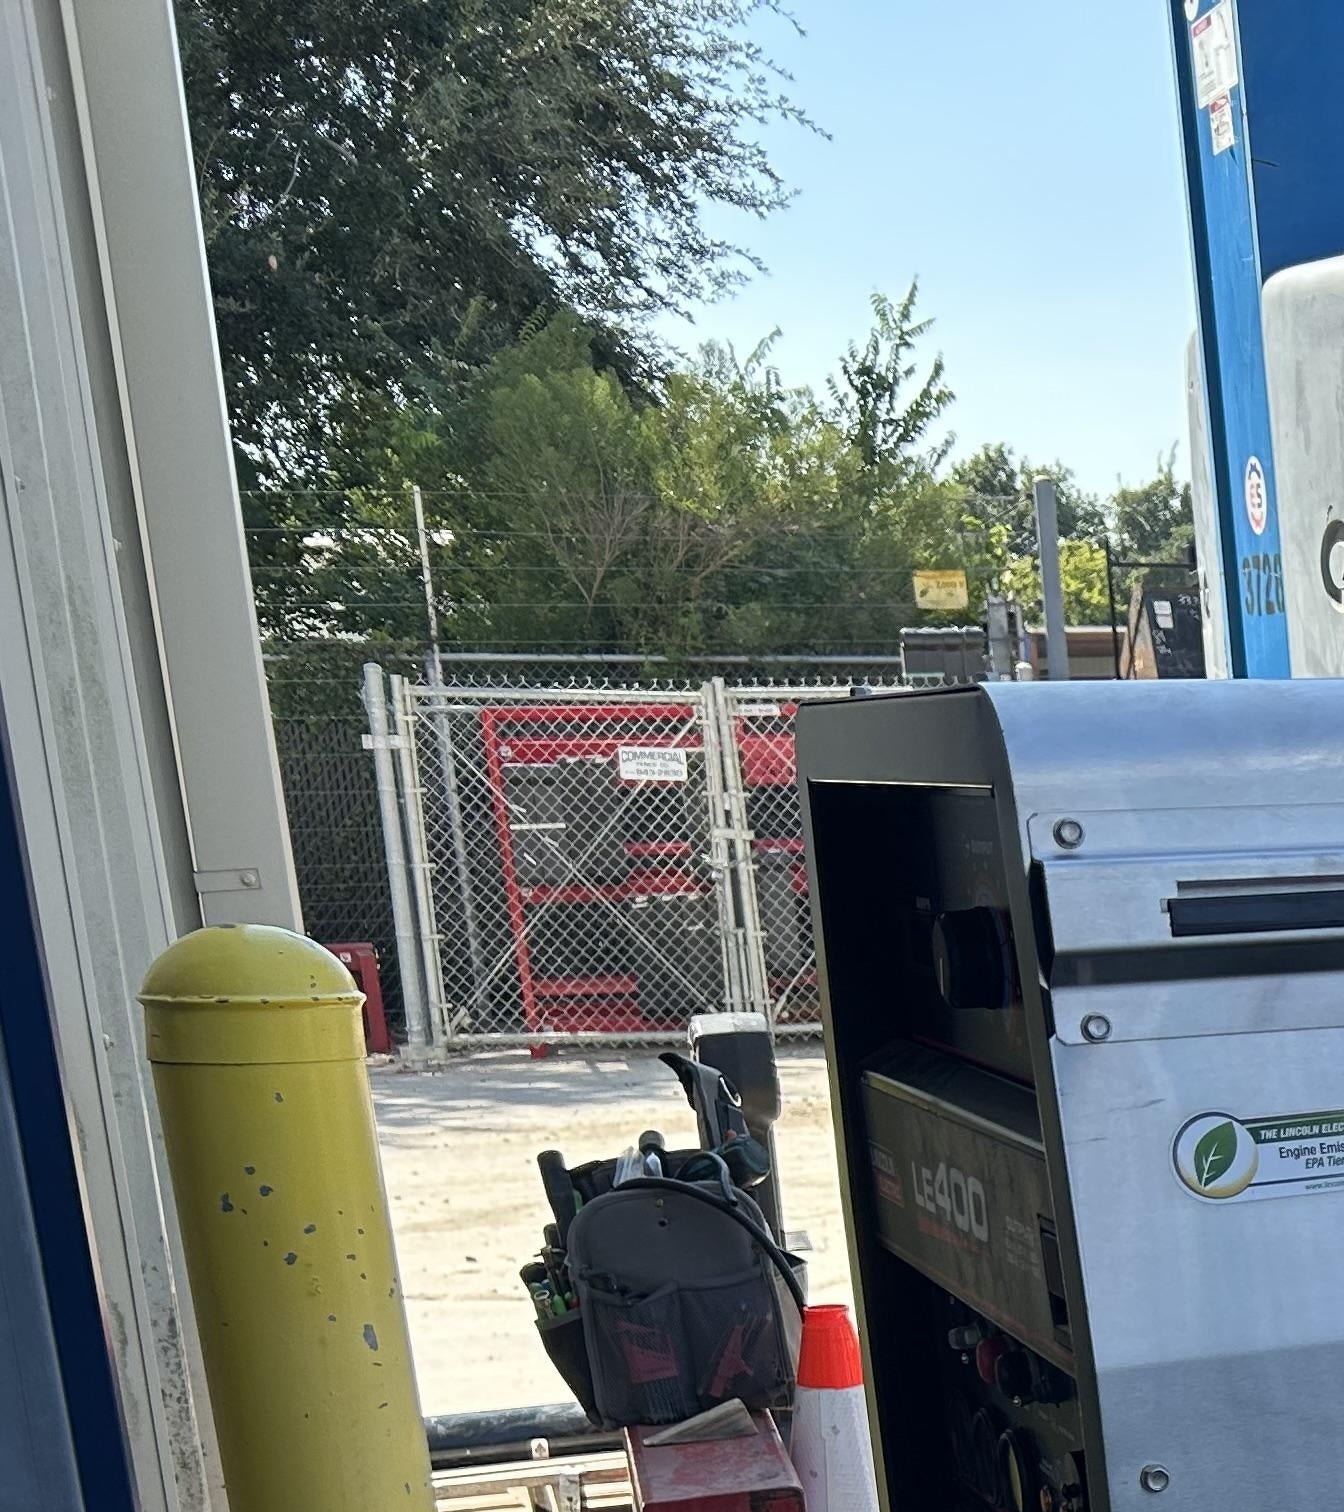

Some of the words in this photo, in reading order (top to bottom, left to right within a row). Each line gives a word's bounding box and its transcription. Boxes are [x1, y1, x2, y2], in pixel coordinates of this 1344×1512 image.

[1260, 1129, 1278, 1140] THE
[1280, 1125, 1320, 1138] LINCOLN
[1279, 1145, 1317, 1160] Engine
[1305, 1158, 1325, 1170] EPA
